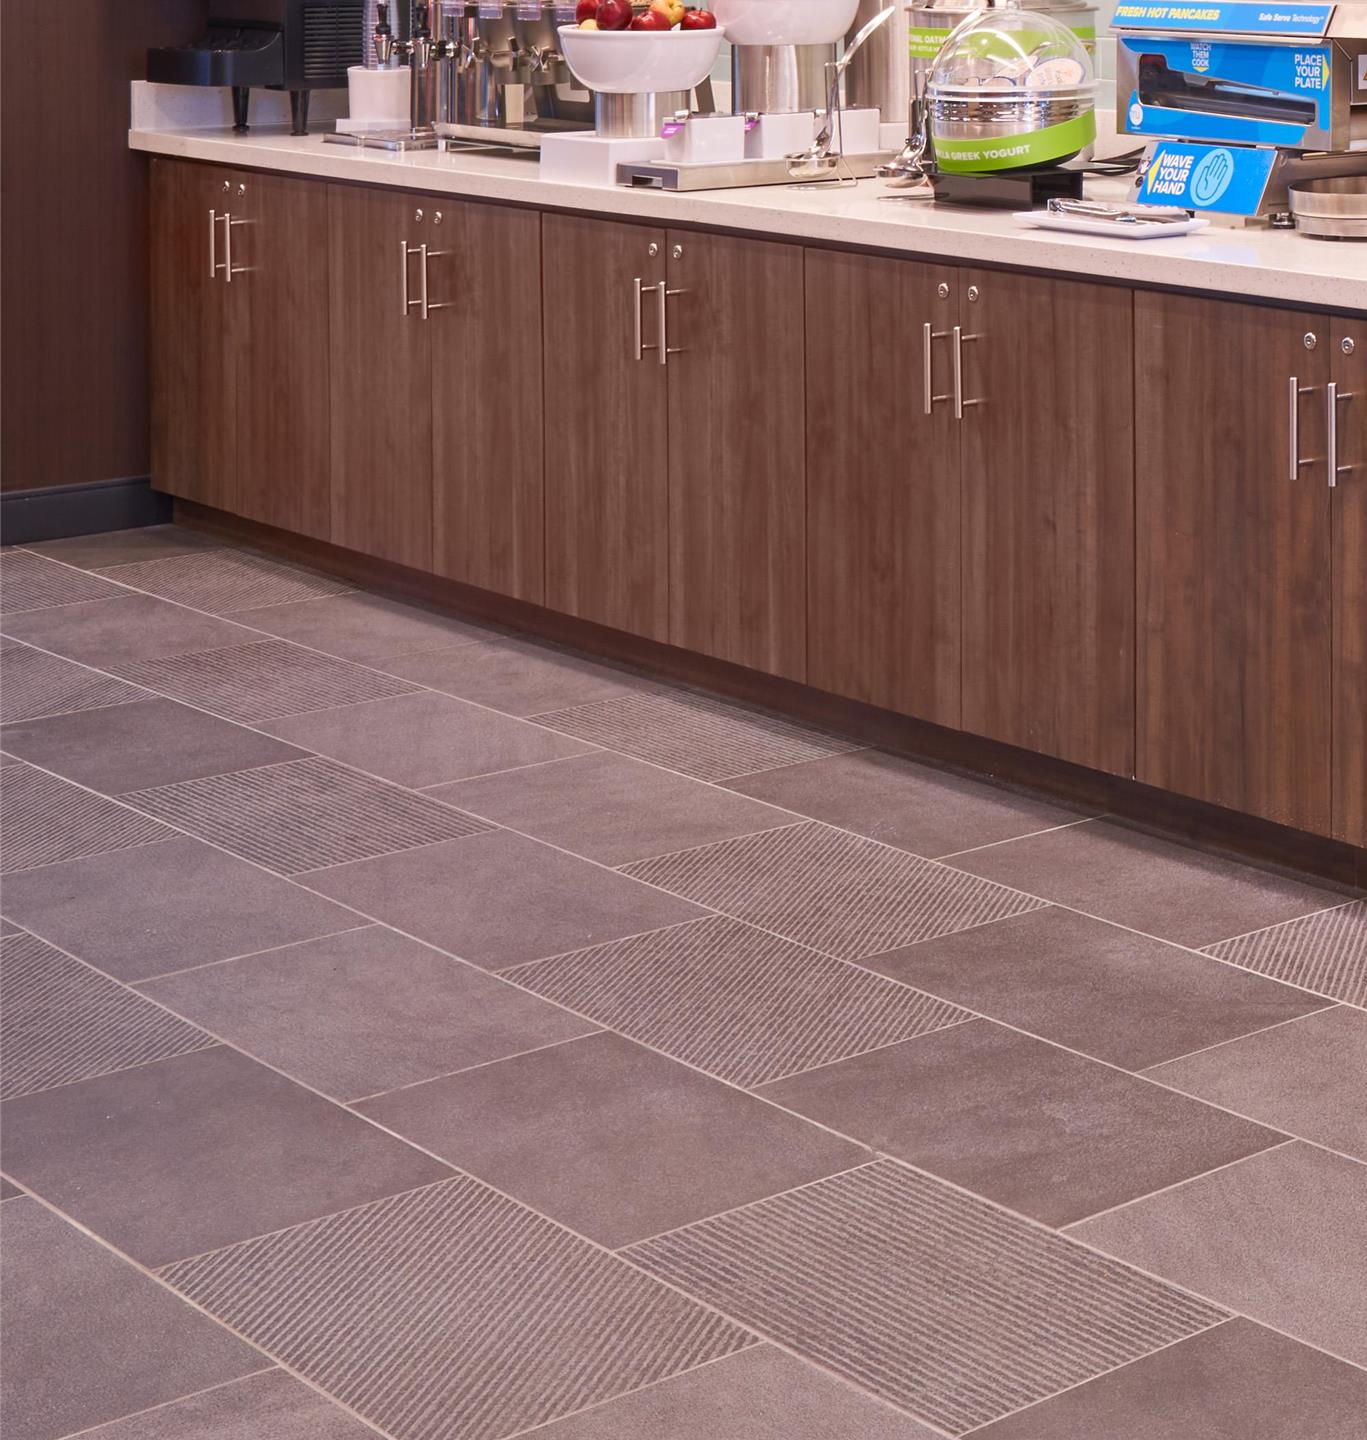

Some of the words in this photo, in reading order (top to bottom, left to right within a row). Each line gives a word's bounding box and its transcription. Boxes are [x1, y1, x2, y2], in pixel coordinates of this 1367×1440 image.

[1115, 6, 1147, 17] FRESH
[1147, 7, 1169, 18] HOT
[1168, 8, 1220, 21] PANCAKES
[1258, 12, 1273, 22] Safe
[1273, 13, 1291, 23] Serve
[1192, 50, 1209, 60] THEM
[1294, 53, 1322, 66] PLACE
[1191, 58, 1209, 67] COOK
[1295, 66, 1320, 77] YOUR
[1294, 77, 1322, 89] PLATE
[950, 151, 981, 161] GREEK
[983, 144, 1031, 160] YOGURT
[1162, 153, 1195, 169] WAVE
[1159, 167, 1190, 181] YOUR
[1152, 180, 1186, 196] HAND
